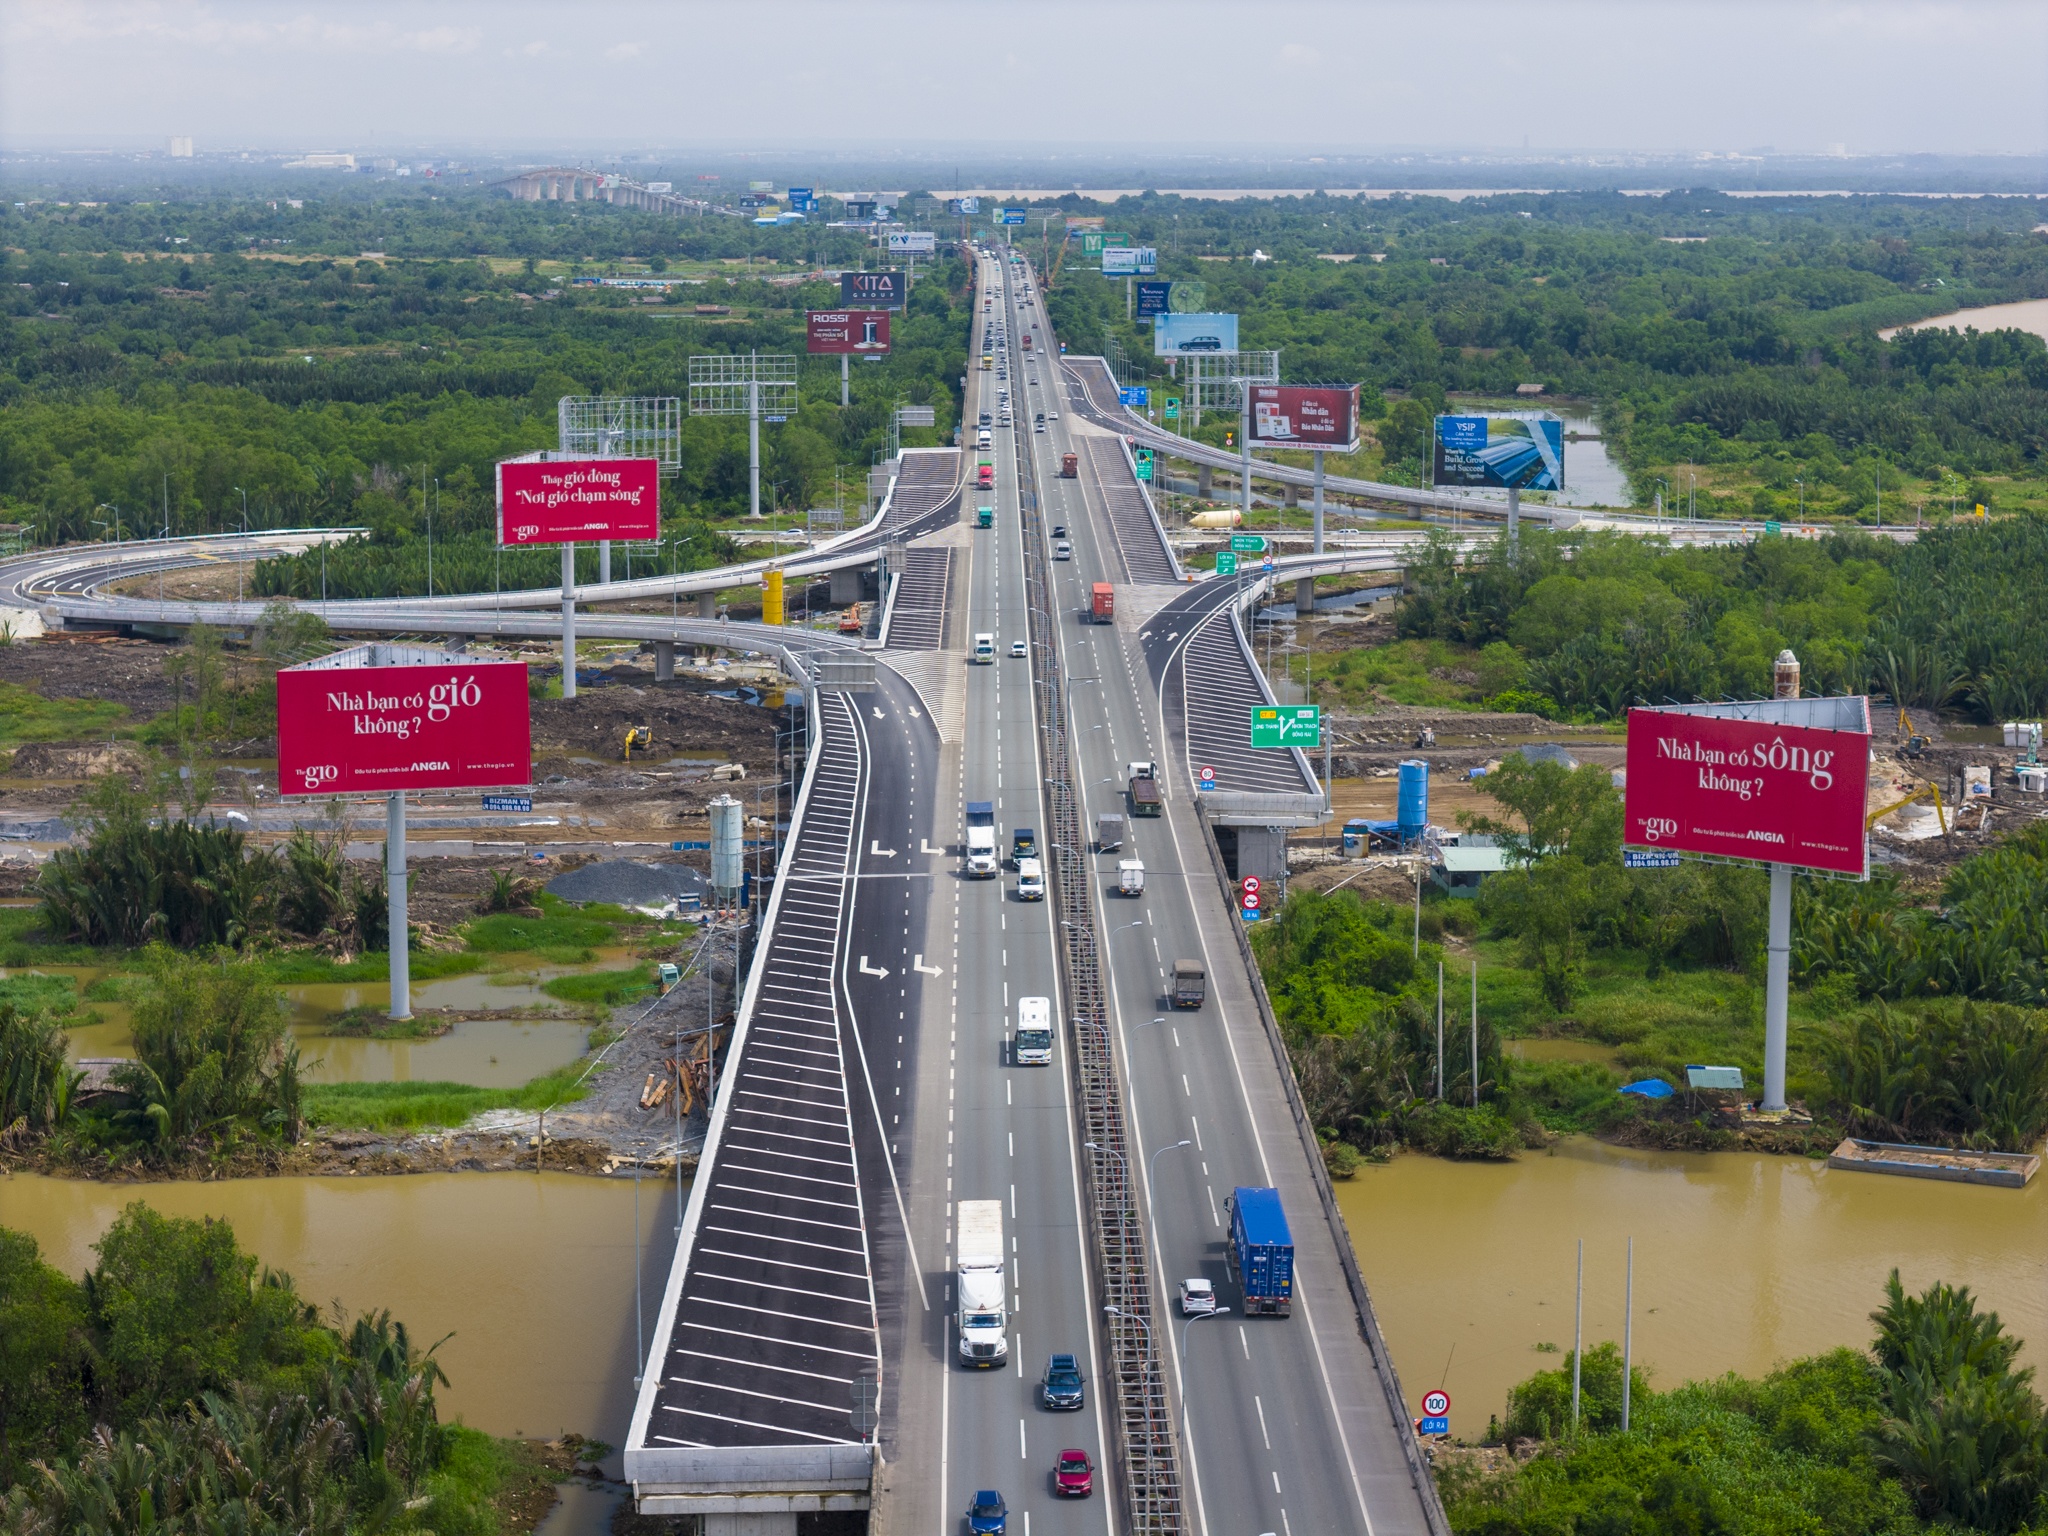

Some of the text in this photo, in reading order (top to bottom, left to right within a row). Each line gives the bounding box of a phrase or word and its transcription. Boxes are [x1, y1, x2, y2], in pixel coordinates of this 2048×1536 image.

[853, 276, 893, 290] KITA
[813, 315, 848, 323] ROSSI
[844, 329, 848, 341] 1
[1456, 423, 1476, 431] VSIP
[1444, 455, 1484, 464] Build, Grow
[1457, 464, 1485, 472] Succeed
[541, 468, 621, 489] Tháp gió đông
[547, 490, 569, 509] gió
[570, 487, 607, 505] chạm
[326, 675, 481, 722] Nhà bạn có gió
[353, 714, 411, 740] không
[410, 761, 450, 772] ANGIA
[1656, 736, 1834, 791] Nhà bạn có sông
[1698, 766, 1752, 801] không
[1745, 829, 1786, 845] ANGIA
[1801, 841, 1850, 853] www.thegio.vn
[1427, 1397, 1446, 1411] 100
[1424, 1419, 1446, 1430] LỐI RA
